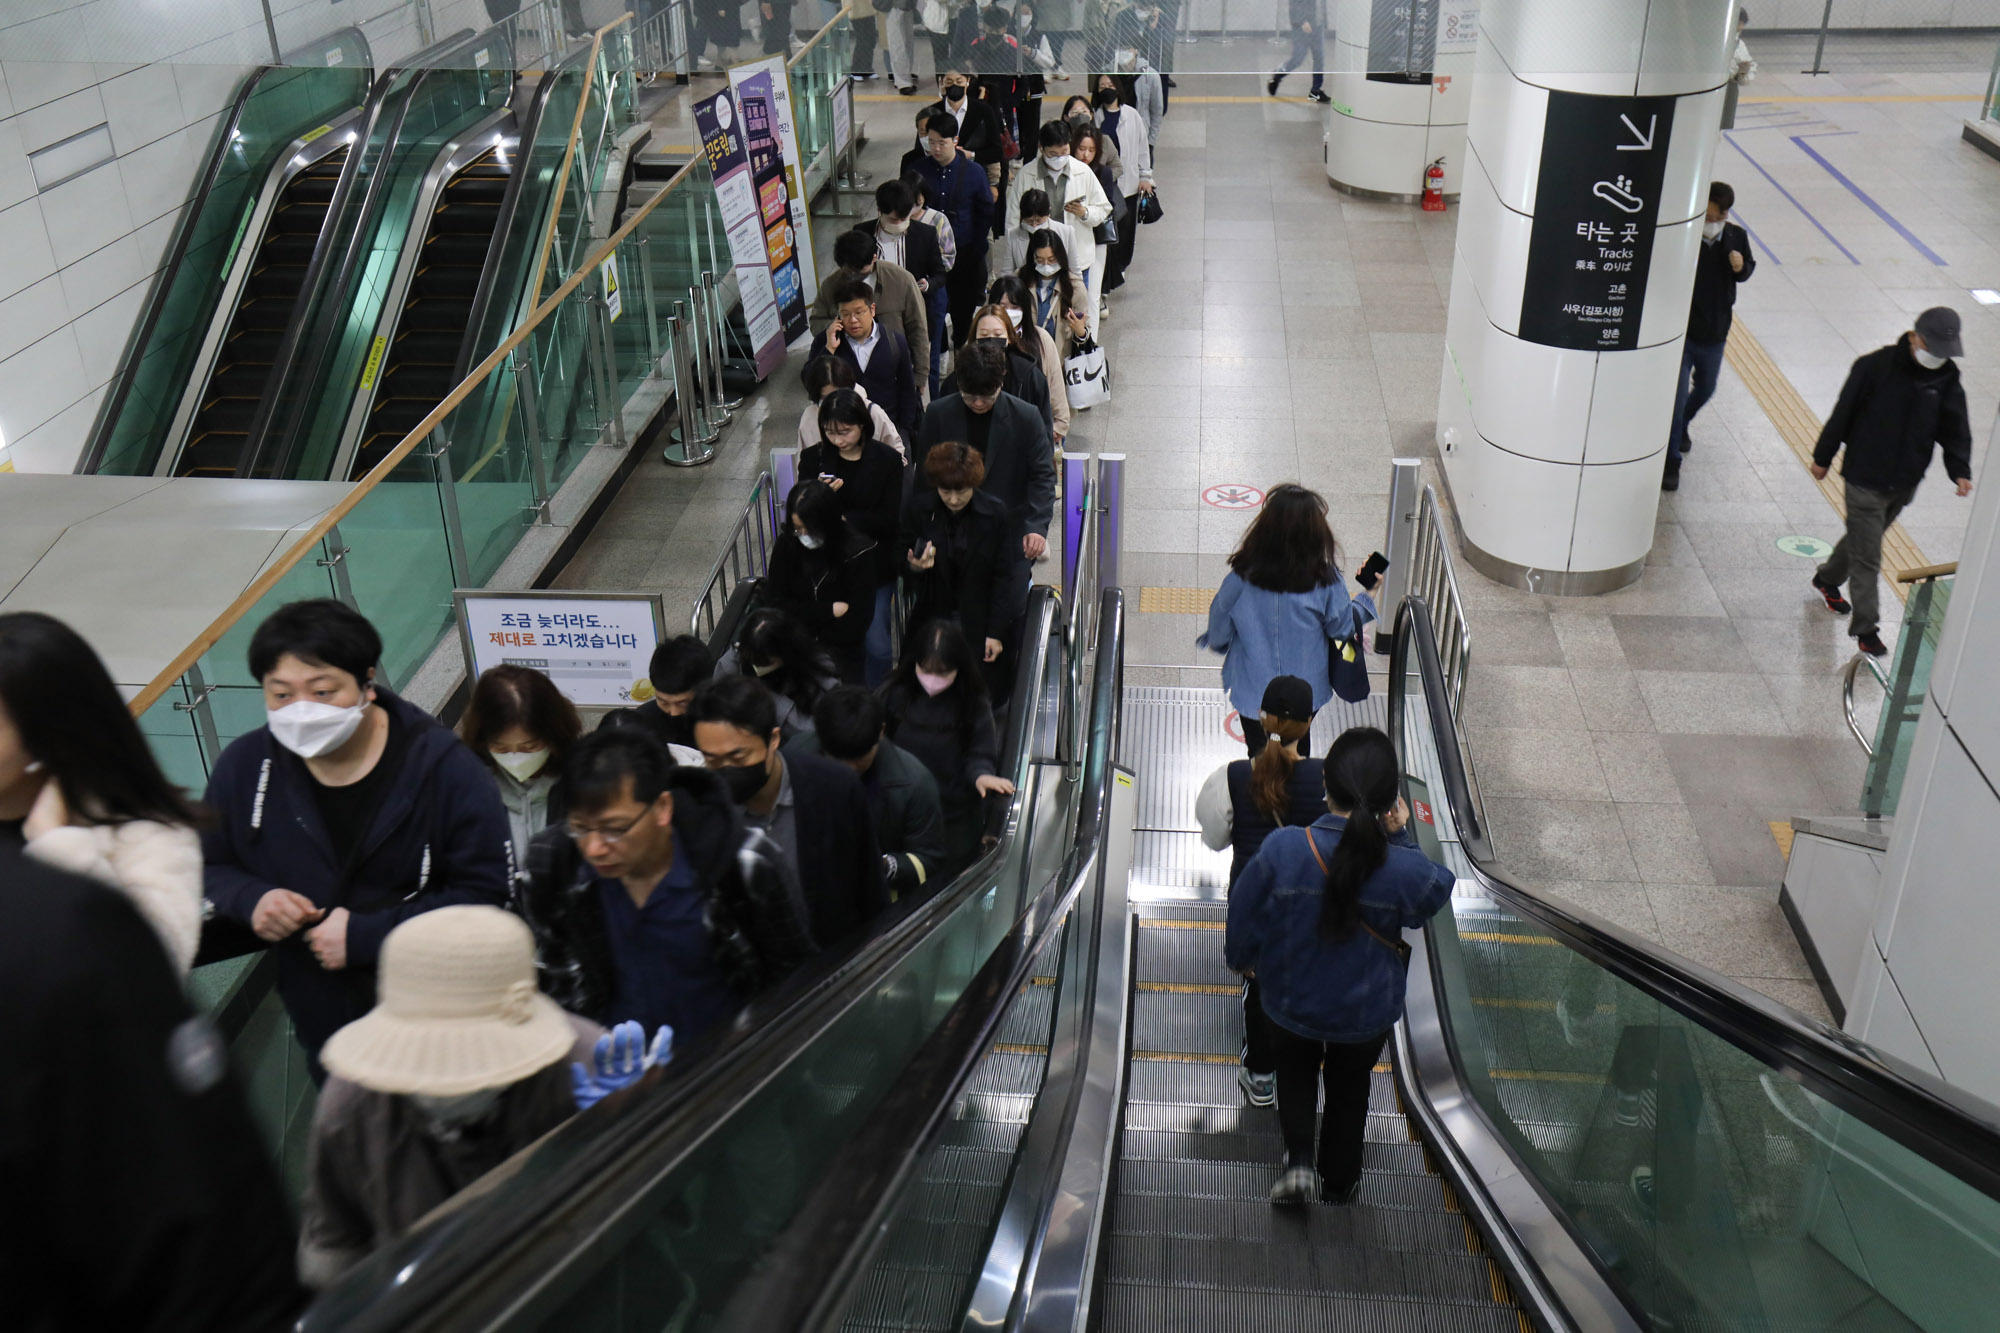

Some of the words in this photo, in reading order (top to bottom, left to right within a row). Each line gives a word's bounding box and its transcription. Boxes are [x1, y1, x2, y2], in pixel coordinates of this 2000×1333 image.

[706, 132, 731, 171] 꿈드림
[1576, 221, 1615, 243] 타는
[1620, 223, 1639, 243] 곳
[1598, 247, 1634, 259] Tracks
[1603, 261, 1632, 271] のりば
[1608, 284, 1627, 294] 고촌
[1562, 304, 1624, 317] 사우(김포시청)
[1602, 328, 1620, 339] 양촌
[501, 613, 532, 628] 조금
[537, 613, 620, 629] 늦더라도...
[489, 631, 537, 647] 제대로
[542, 632, 638, 649] 고치겠습니다
